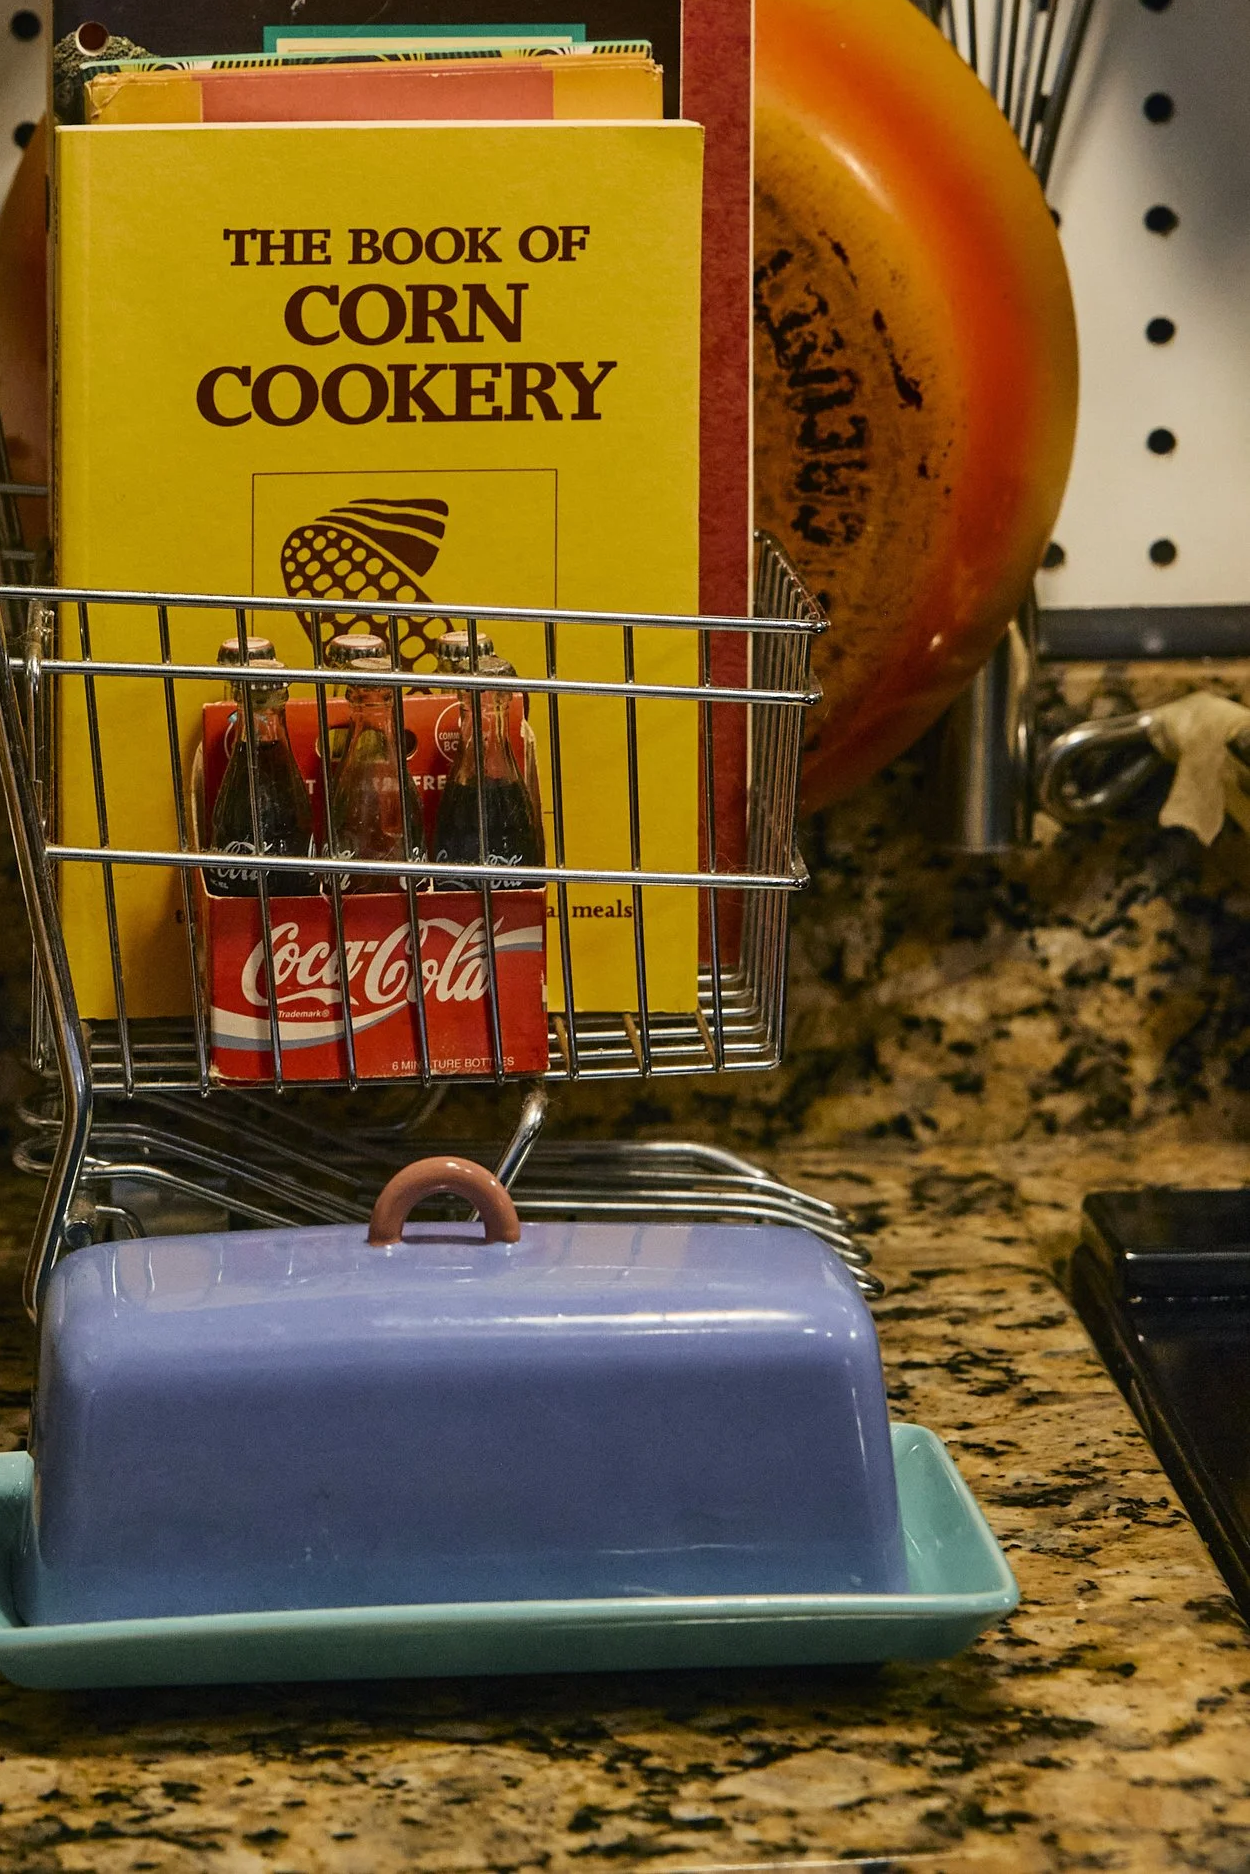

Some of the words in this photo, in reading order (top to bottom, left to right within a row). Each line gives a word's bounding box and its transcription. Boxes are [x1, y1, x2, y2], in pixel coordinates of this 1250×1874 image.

[224, 228, 332, 266] THE
[348, 227, 503, 265] BOOK
[519, 225, 591, 263] OF
[284, 283, 530, 346] CORN
[196, 361, 618, 427] COOKERY
[572, 899, 633, 918] meals
[241, 915, 504, 1006] Coca-Cola
[391, 1061, 399, 1071] 6
[401, 1058, 462, 1071] MINTURE
[464, 1056, 515, 1067] BOTTES
